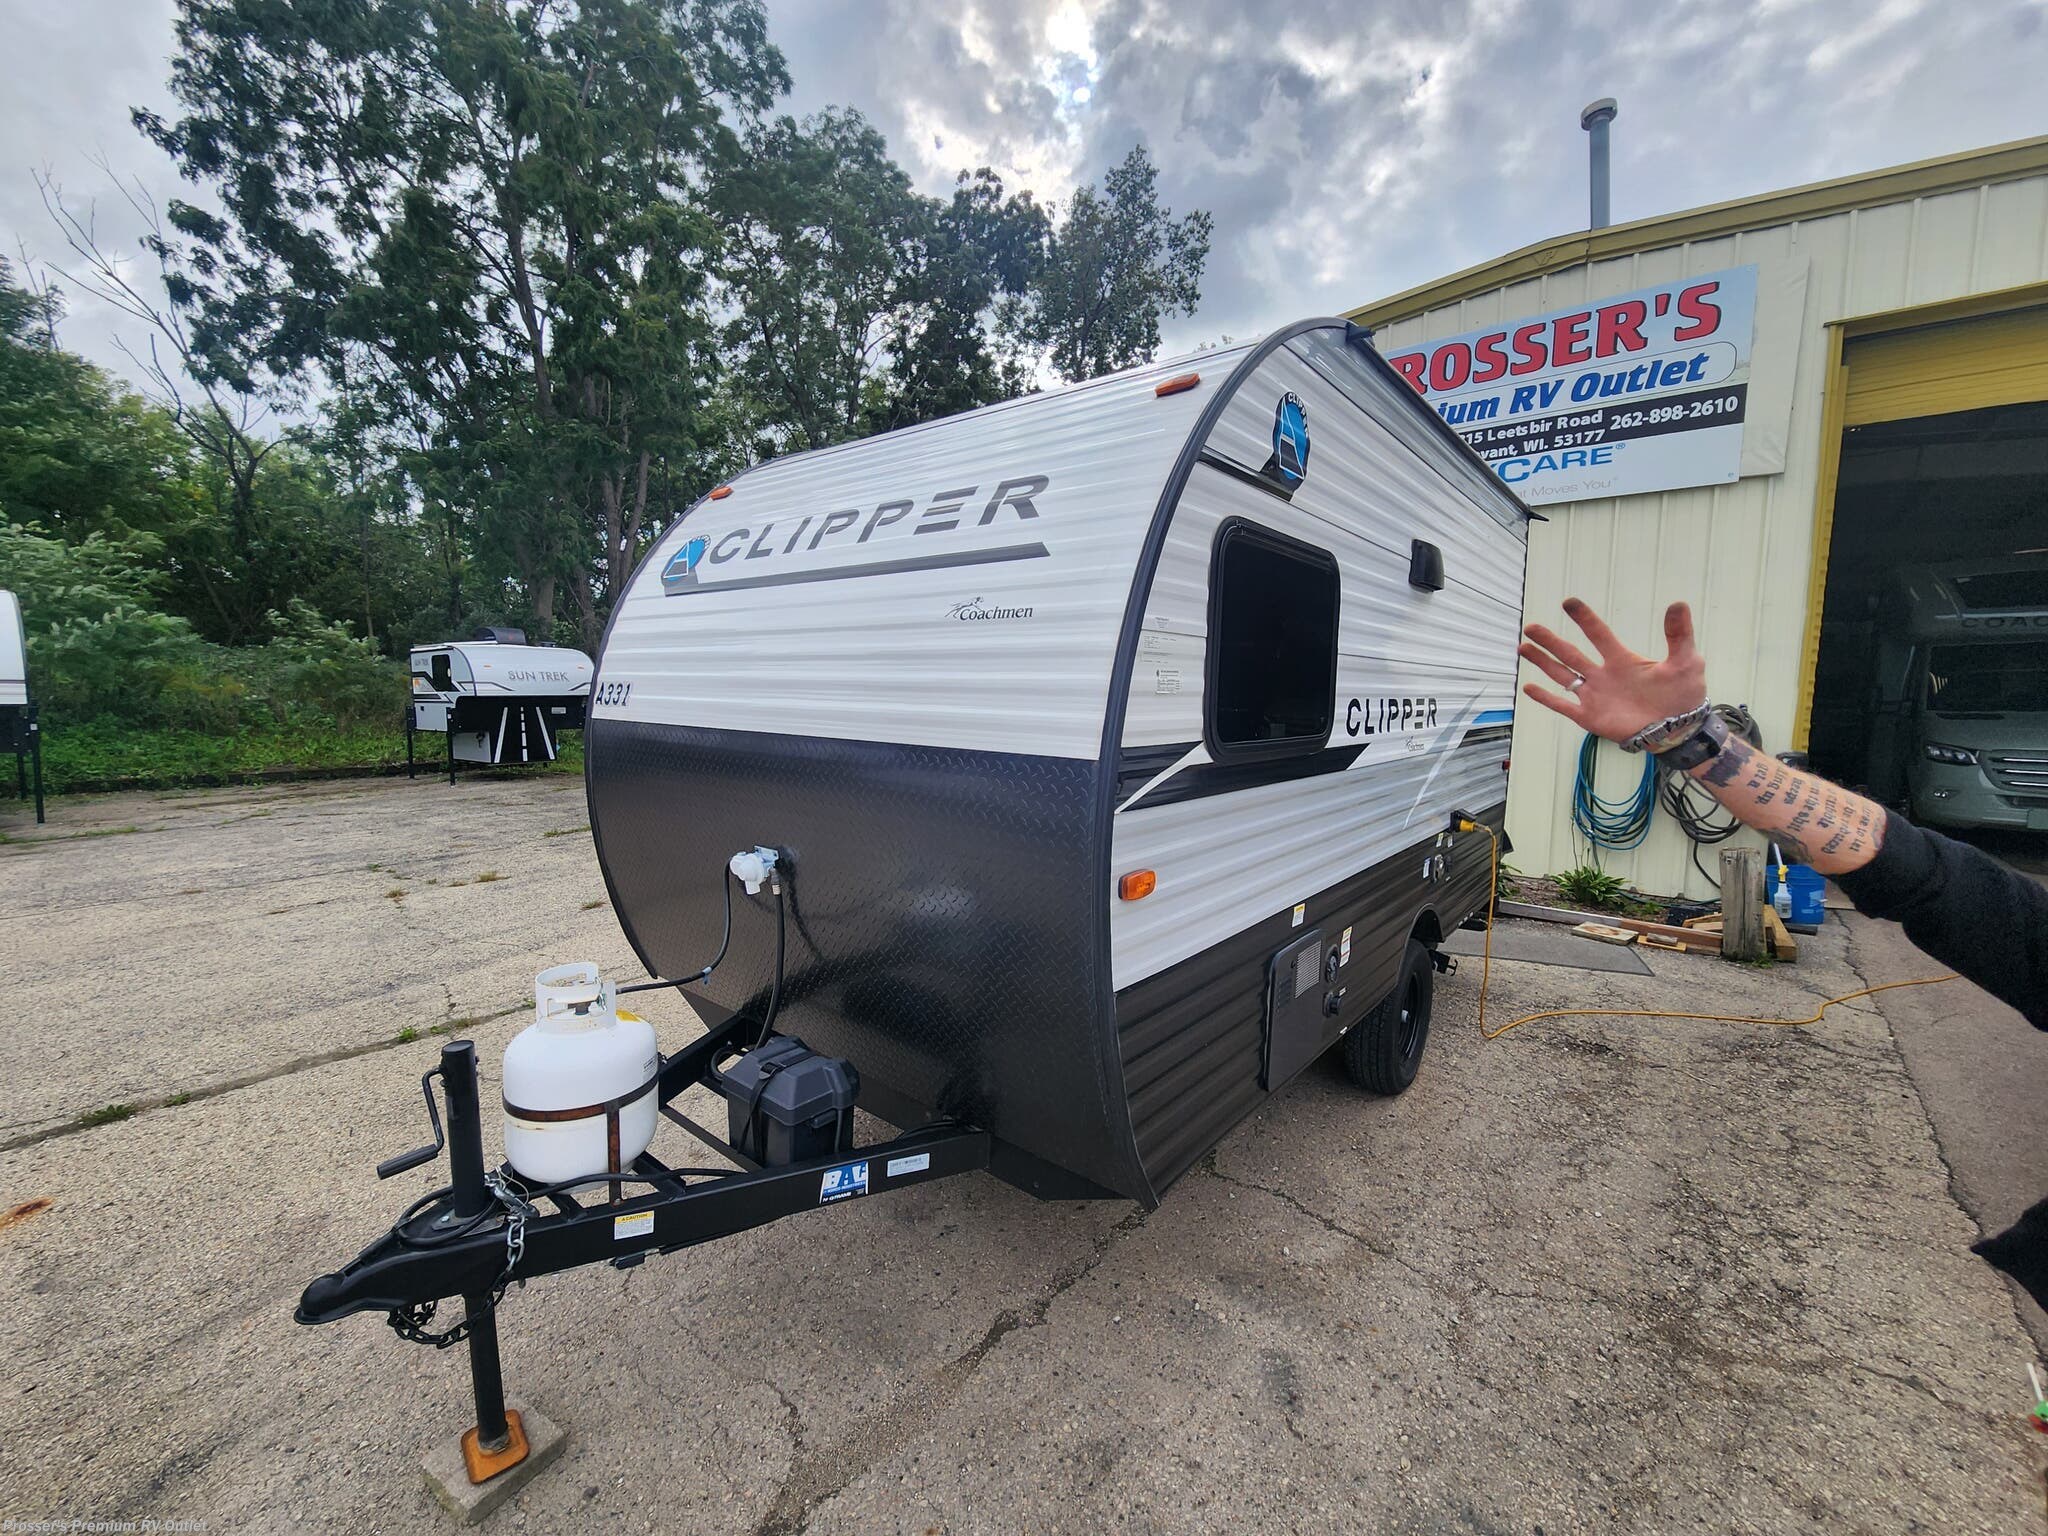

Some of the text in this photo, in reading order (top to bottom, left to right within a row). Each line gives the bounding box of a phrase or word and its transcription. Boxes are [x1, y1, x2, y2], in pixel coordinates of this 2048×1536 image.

[1509, 378, 1565, 414] RV
[1571, 352, 1710, 402] Outlet
[1556, 410, 1604, 430] Road
[1610, 396, 1739, 430] 262-898-2610
[1476, 429, 1606, 461] vant, WI. 53177
[1490, 445, 1614, 483] CARE
[1531, 484, 1579, 498] Moves
[1582, 479, 1612, 490] You
[709, 474, 1050, 565] CLIPPER
[960, 605, 1034, 621] Coachmen
[508, 670, 570, 682] SUN TREK
[595, 681, 631, 706] A331
[1346, 697, 1438, 737] CLIPPER
